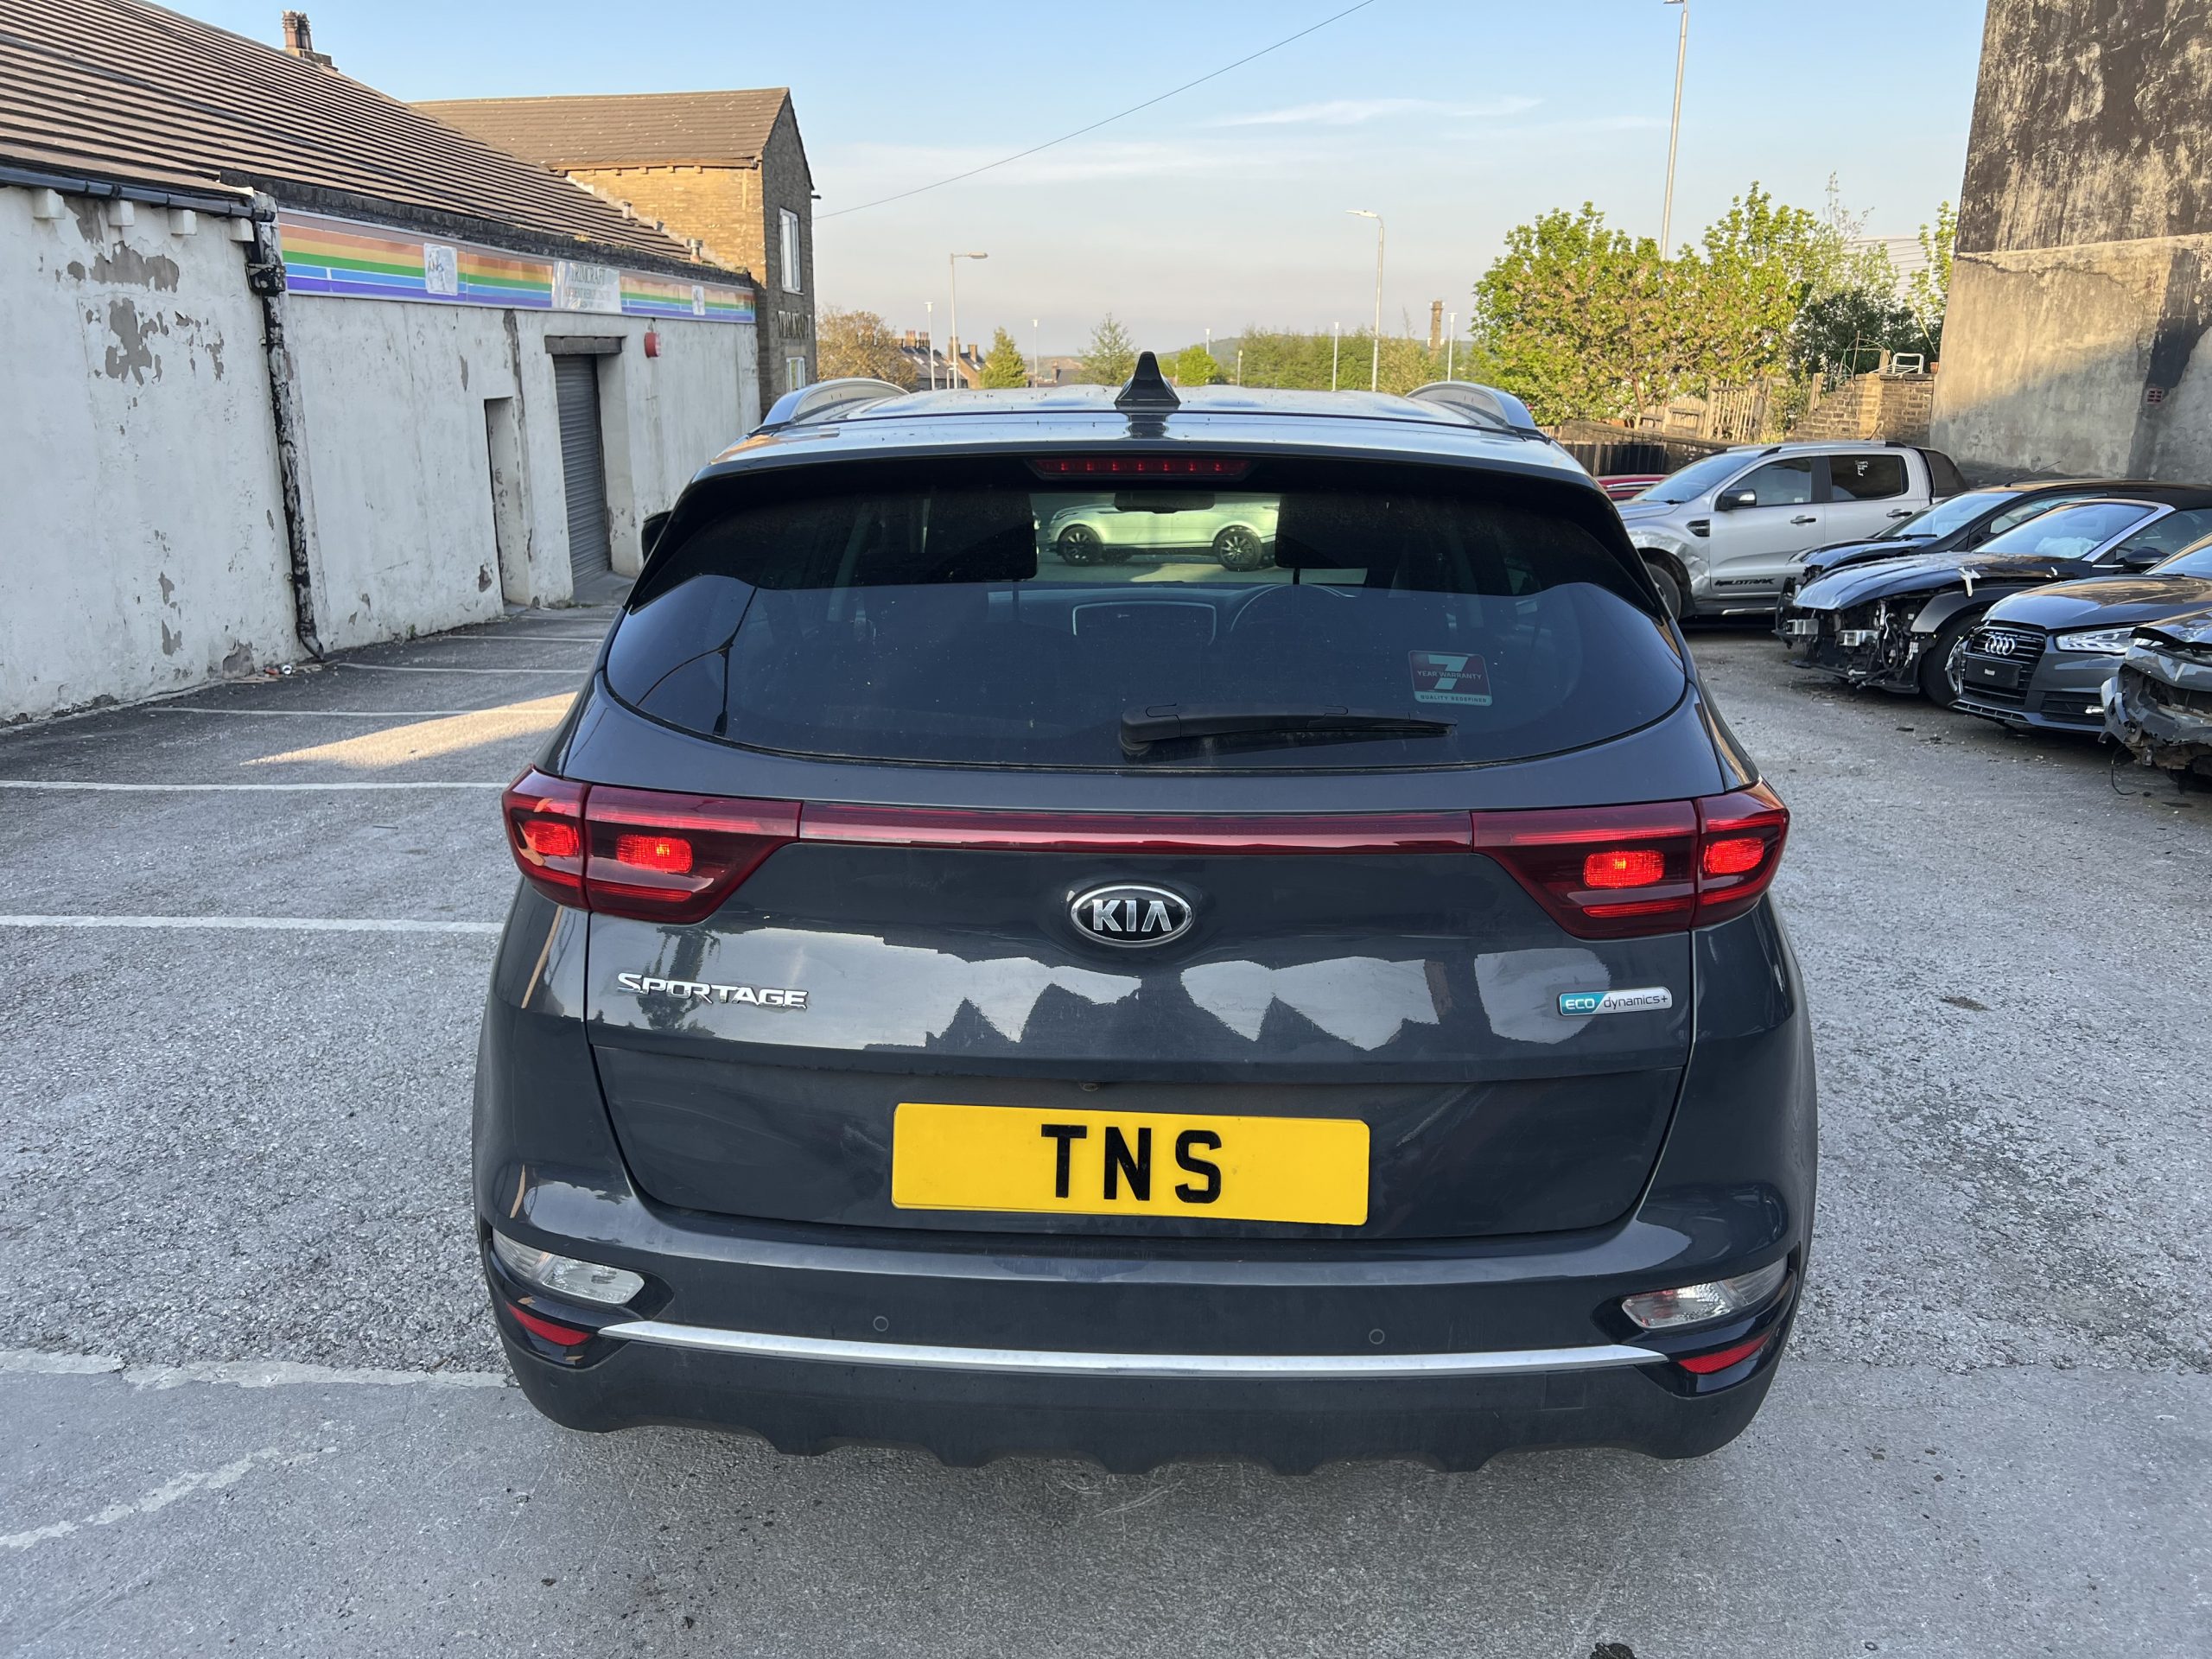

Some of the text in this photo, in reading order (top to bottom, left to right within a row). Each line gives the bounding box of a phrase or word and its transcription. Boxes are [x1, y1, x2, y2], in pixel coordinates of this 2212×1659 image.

[1427, 654, 1469, 690] 7
[1439, 671, 1482, 680] WARRANTY
[1091, 899, 1173, 932] KIA
[617, 972, 809, 1009] SPORTAGE
[1565, 995, 1669, 1010] ECO dynamics+
[1040, 1123, 1223, 1205] TNS
